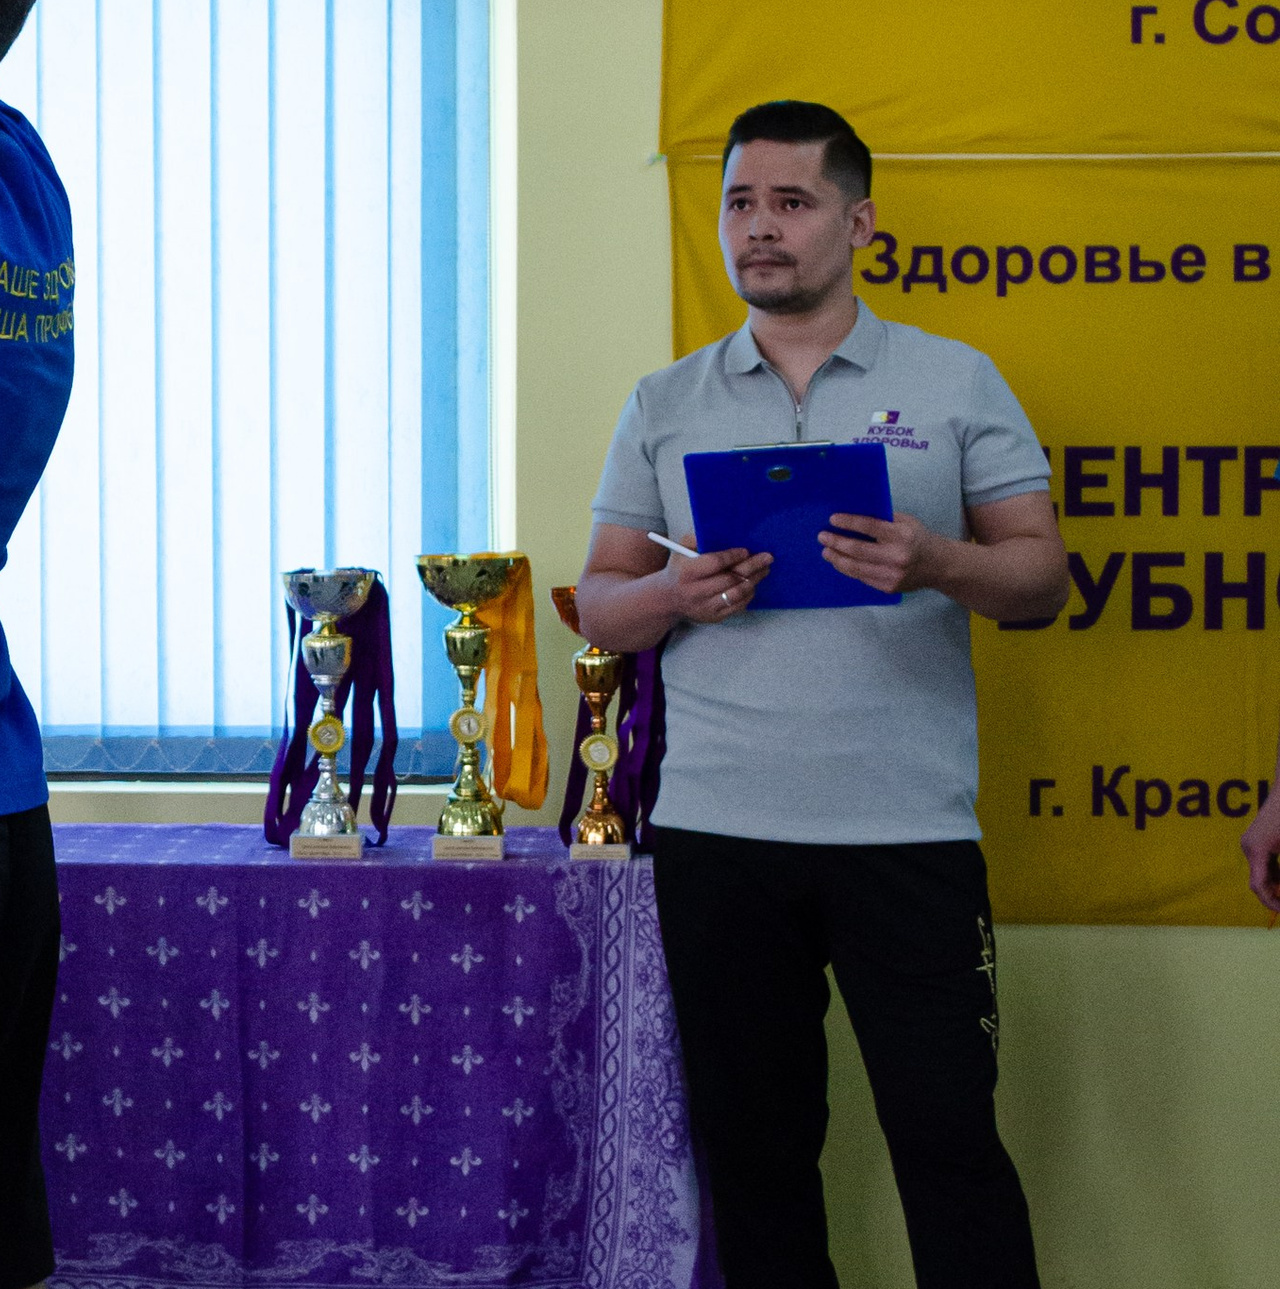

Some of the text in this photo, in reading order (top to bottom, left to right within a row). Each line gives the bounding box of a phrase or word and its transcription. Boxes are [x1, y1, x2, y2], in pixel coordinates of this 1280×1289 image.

[1131, 6, 1165, 44] г.
[860, 231, 1271, 297] Здоровье в
[867, 425, 915, 437] КУБОК
[1042, 445, 1280, 521] ЕНТР
[998, 551, 1280, 631] УБН
[1028, 778, 1064, 817] г.
